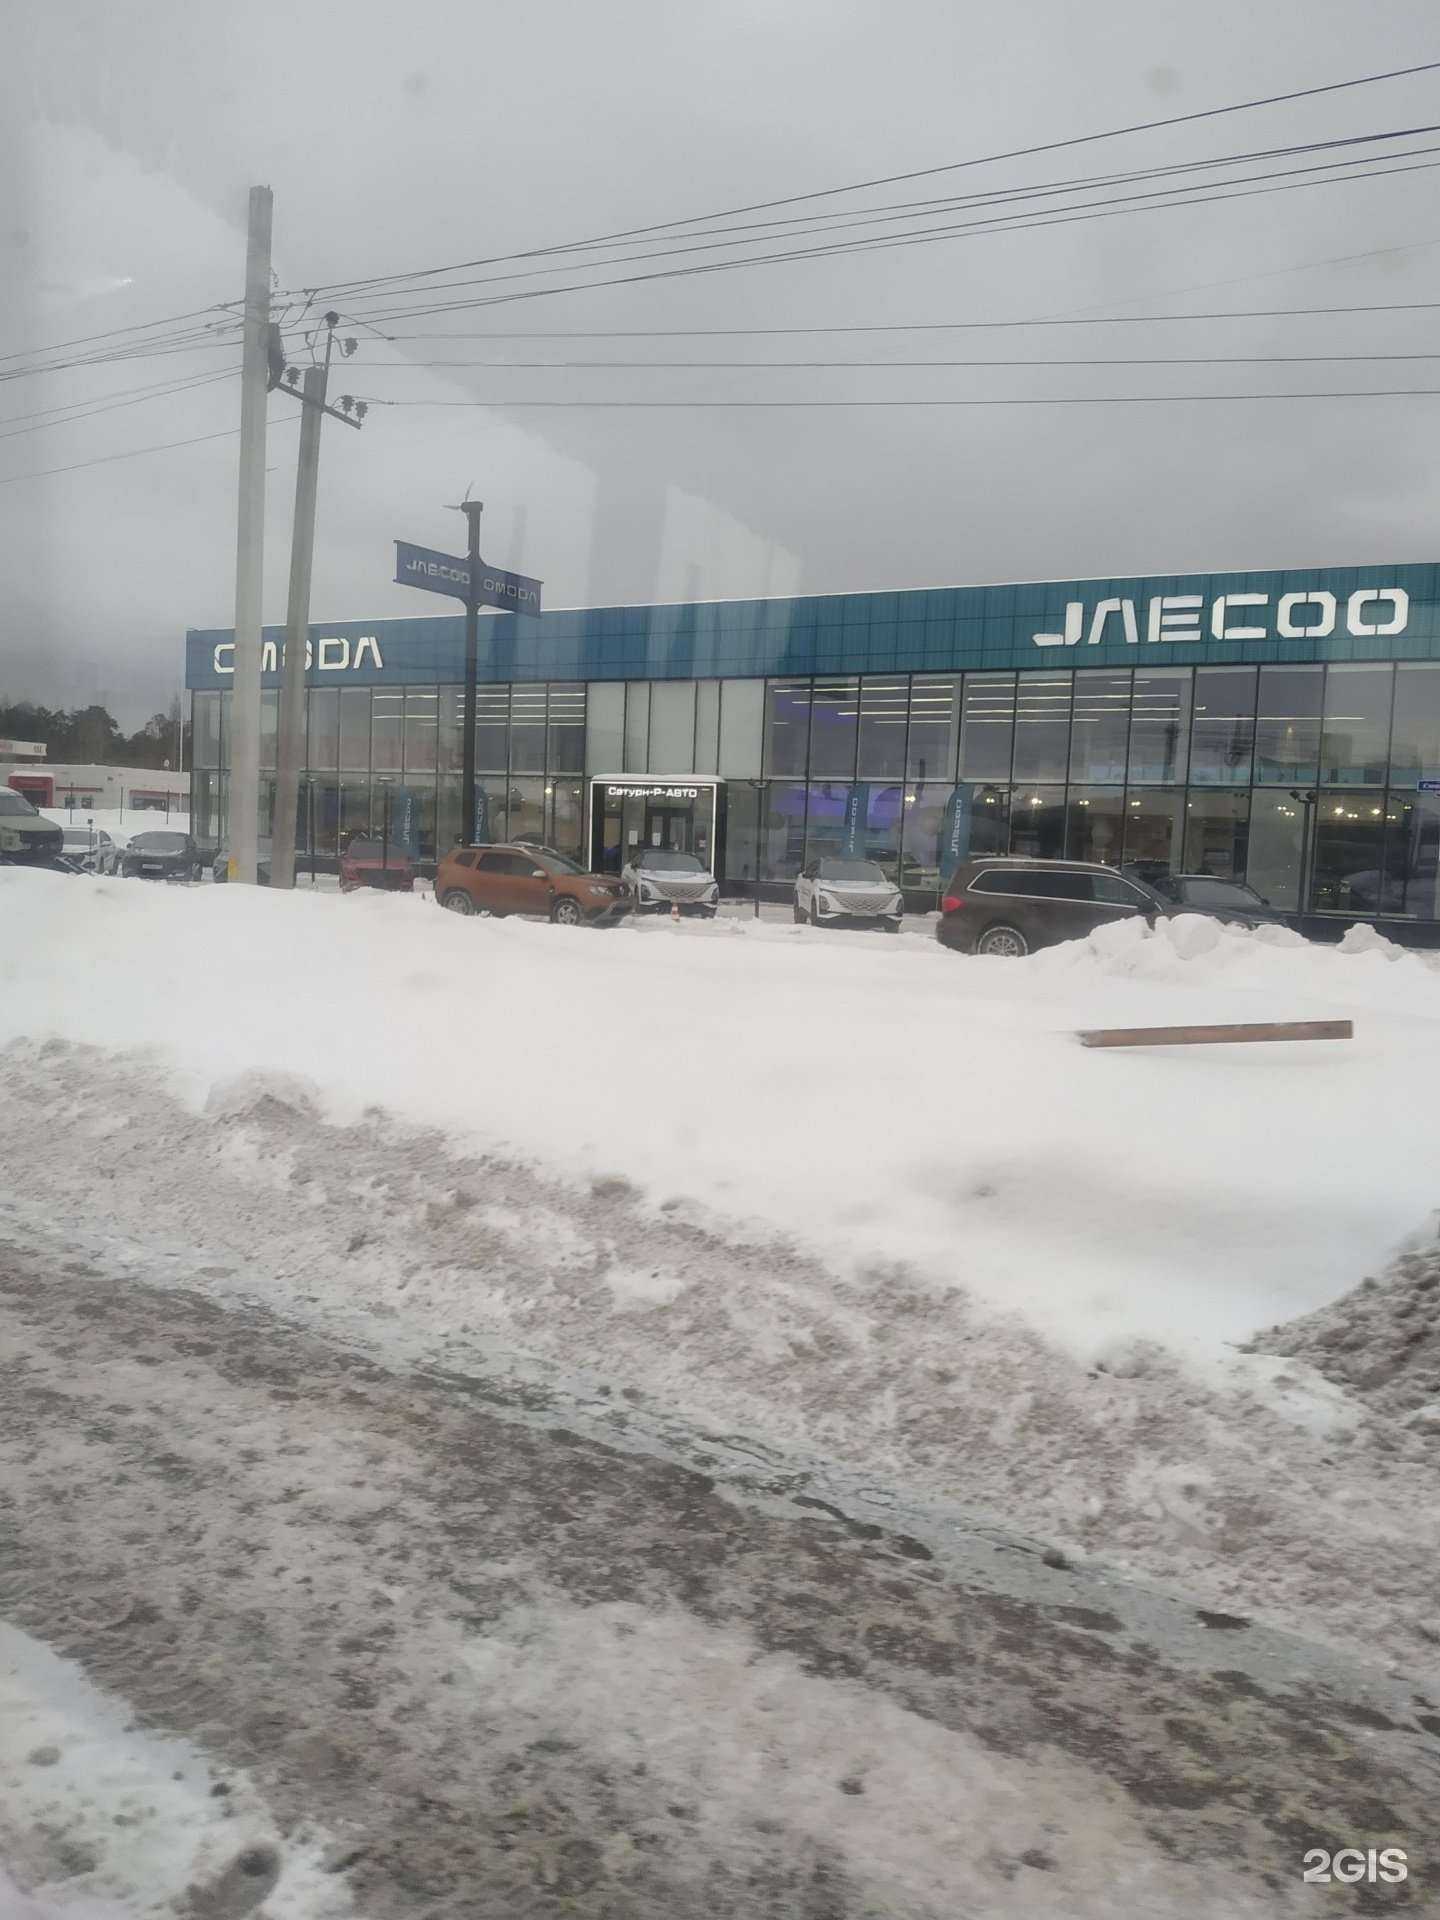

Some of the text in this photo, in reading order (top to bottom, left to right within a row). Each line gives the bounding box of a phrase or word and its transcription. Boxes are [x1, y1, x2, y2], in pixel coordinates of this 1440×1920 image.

[406, 559, 471, 585] JAECOO
[483, 578, 537, 603] OMODA
[1032, 587, 1410, 647] JAECOO
